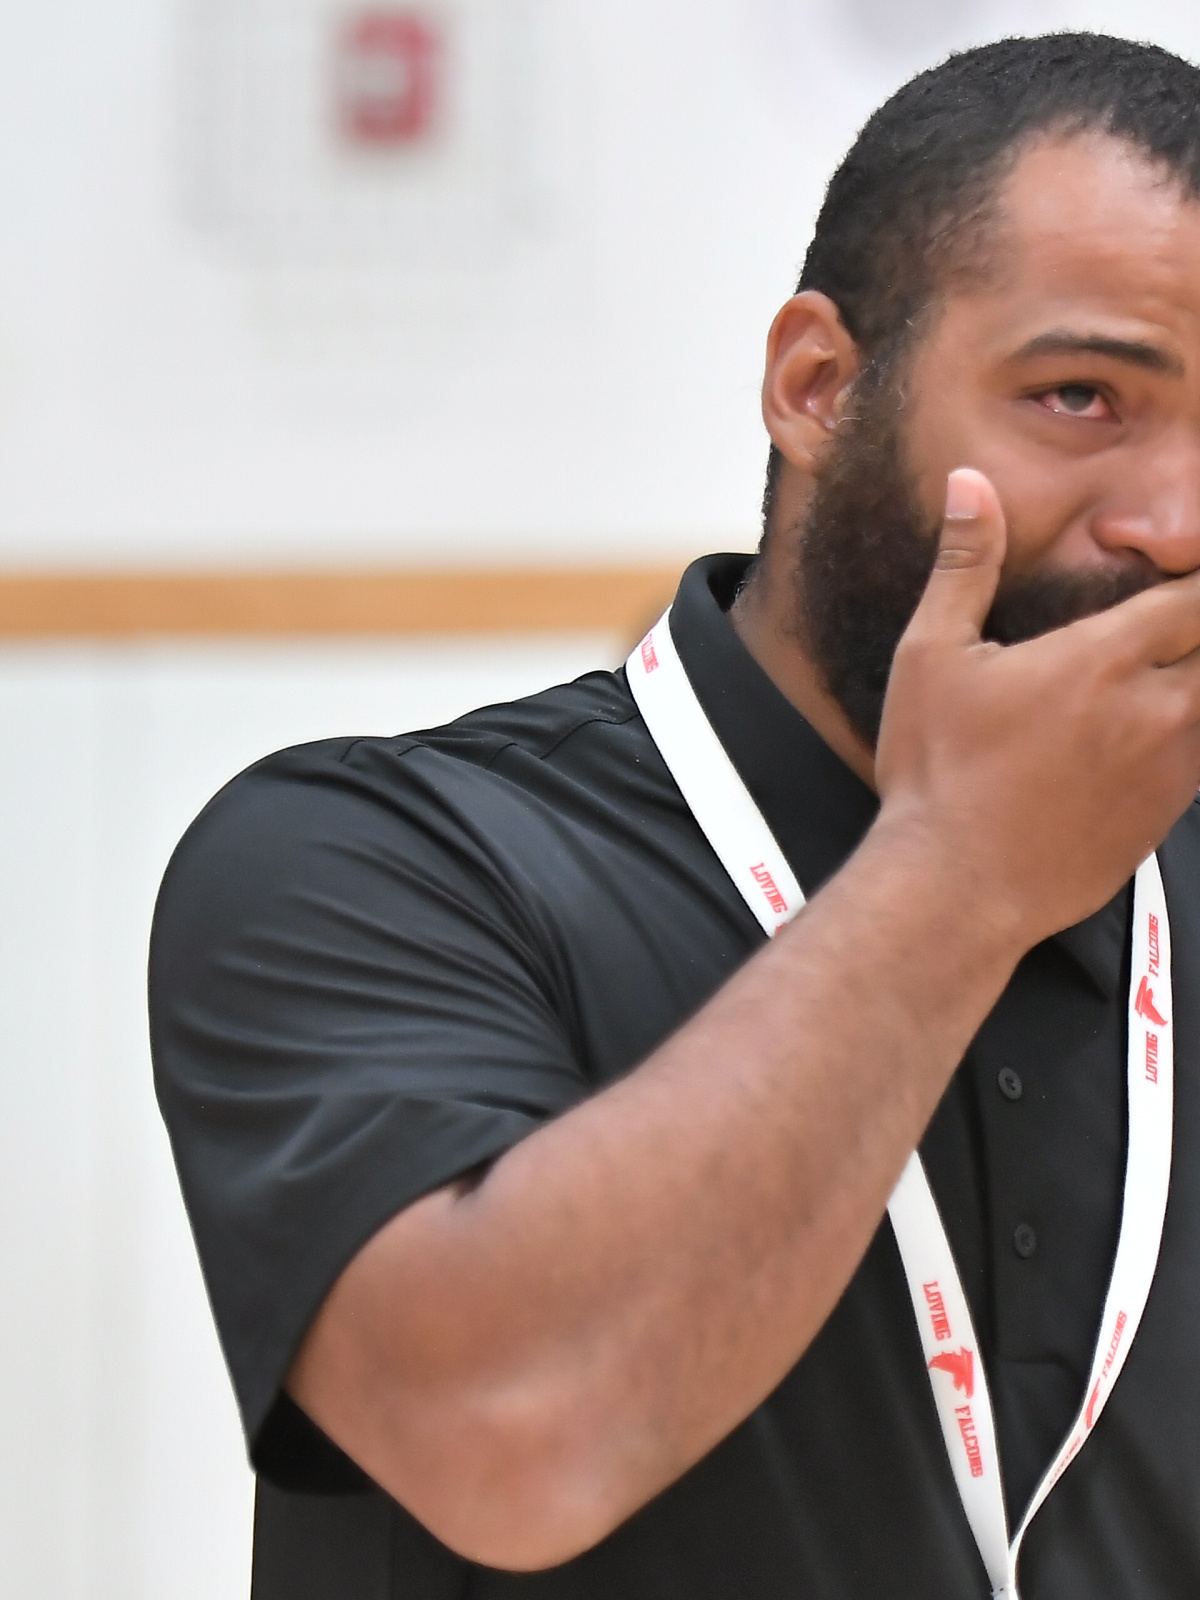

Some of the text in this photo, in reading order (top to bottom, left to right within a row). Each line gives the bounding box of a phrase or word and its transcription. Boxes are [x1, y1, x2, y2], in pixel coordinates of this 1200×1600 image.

[749, 862, 789, 914] LOVING
[1145, 912, 1159, 1084] LOVING FALCONS
[923, 1281, 984, 1478] LOVING FALCONS
[1101, 1310, 1128, 1380] FALCONS
